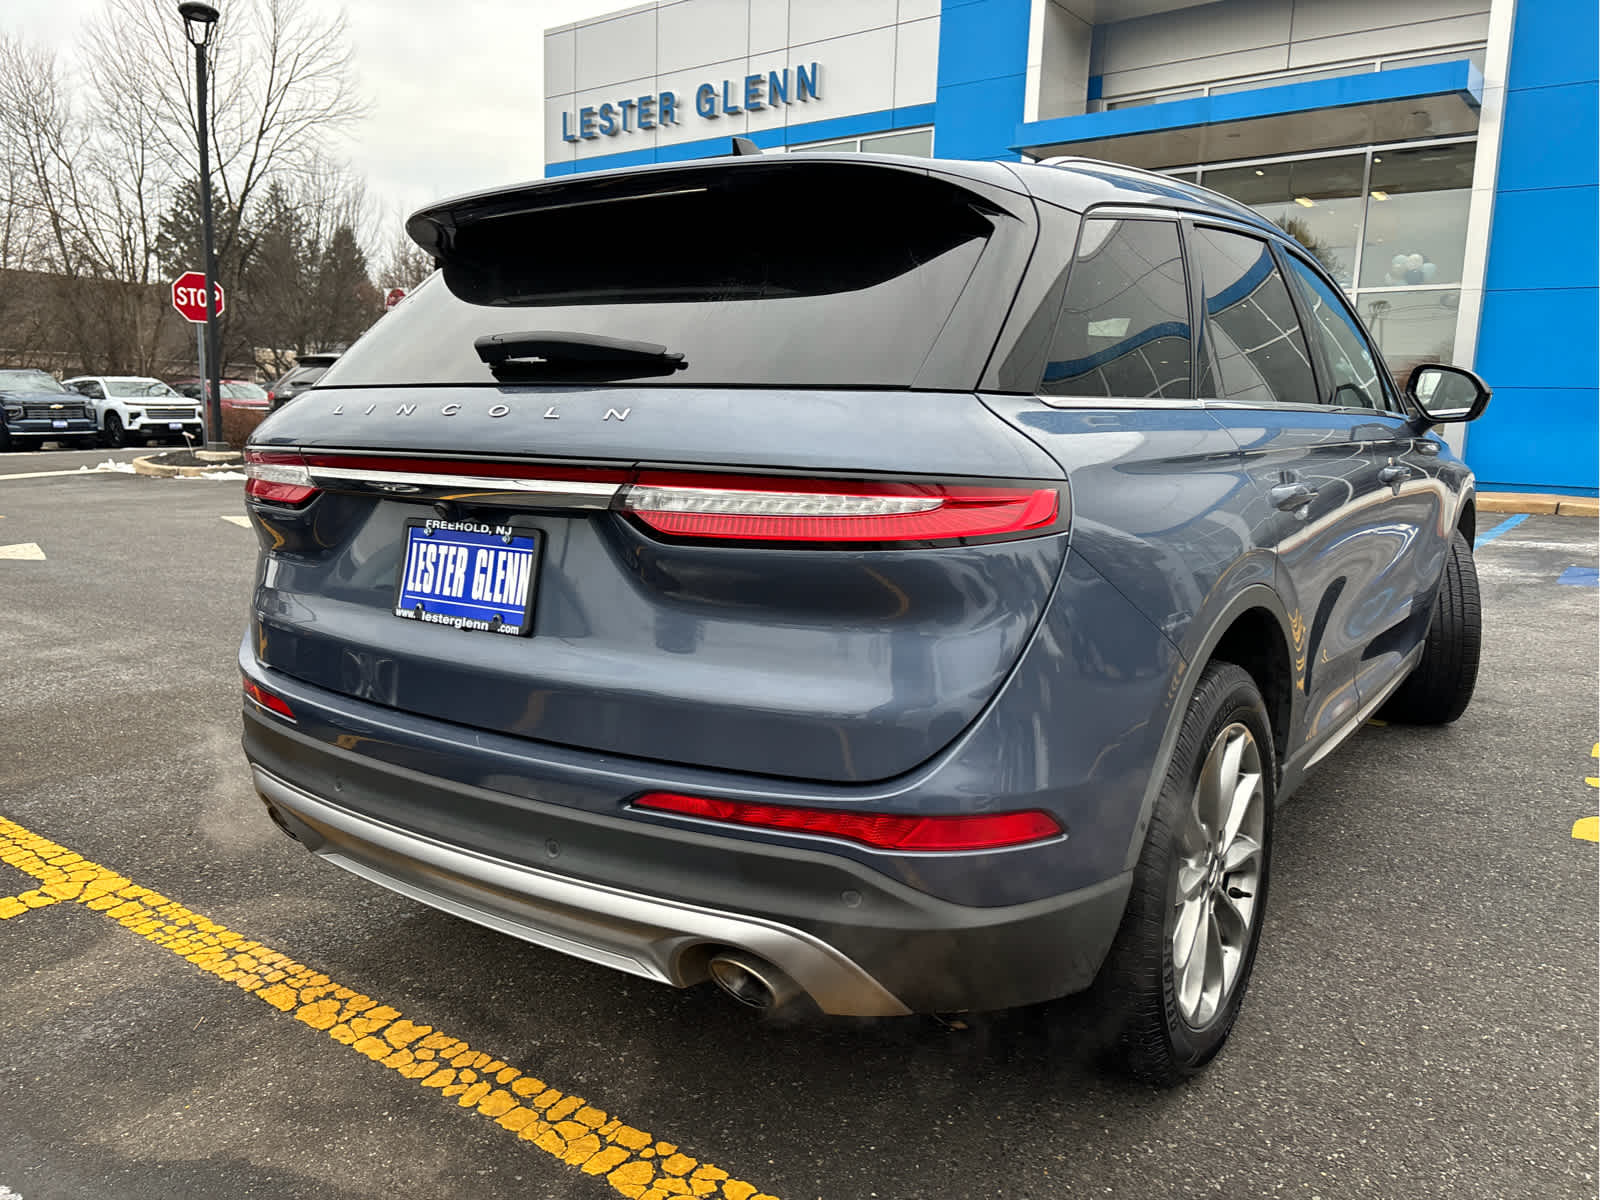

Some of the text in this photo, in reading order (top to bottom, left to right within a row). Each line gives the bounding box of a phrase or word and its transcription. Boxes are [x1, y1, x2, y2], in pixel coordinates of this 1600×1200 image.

[562, 62, 820, 142] LESTER GLENN
[333, 403, 631, 421] LINCOLN
[425, 519, 512, 536] FREEHOLD, NJ
[407, 542, 533, 606] LESTER GLENN
